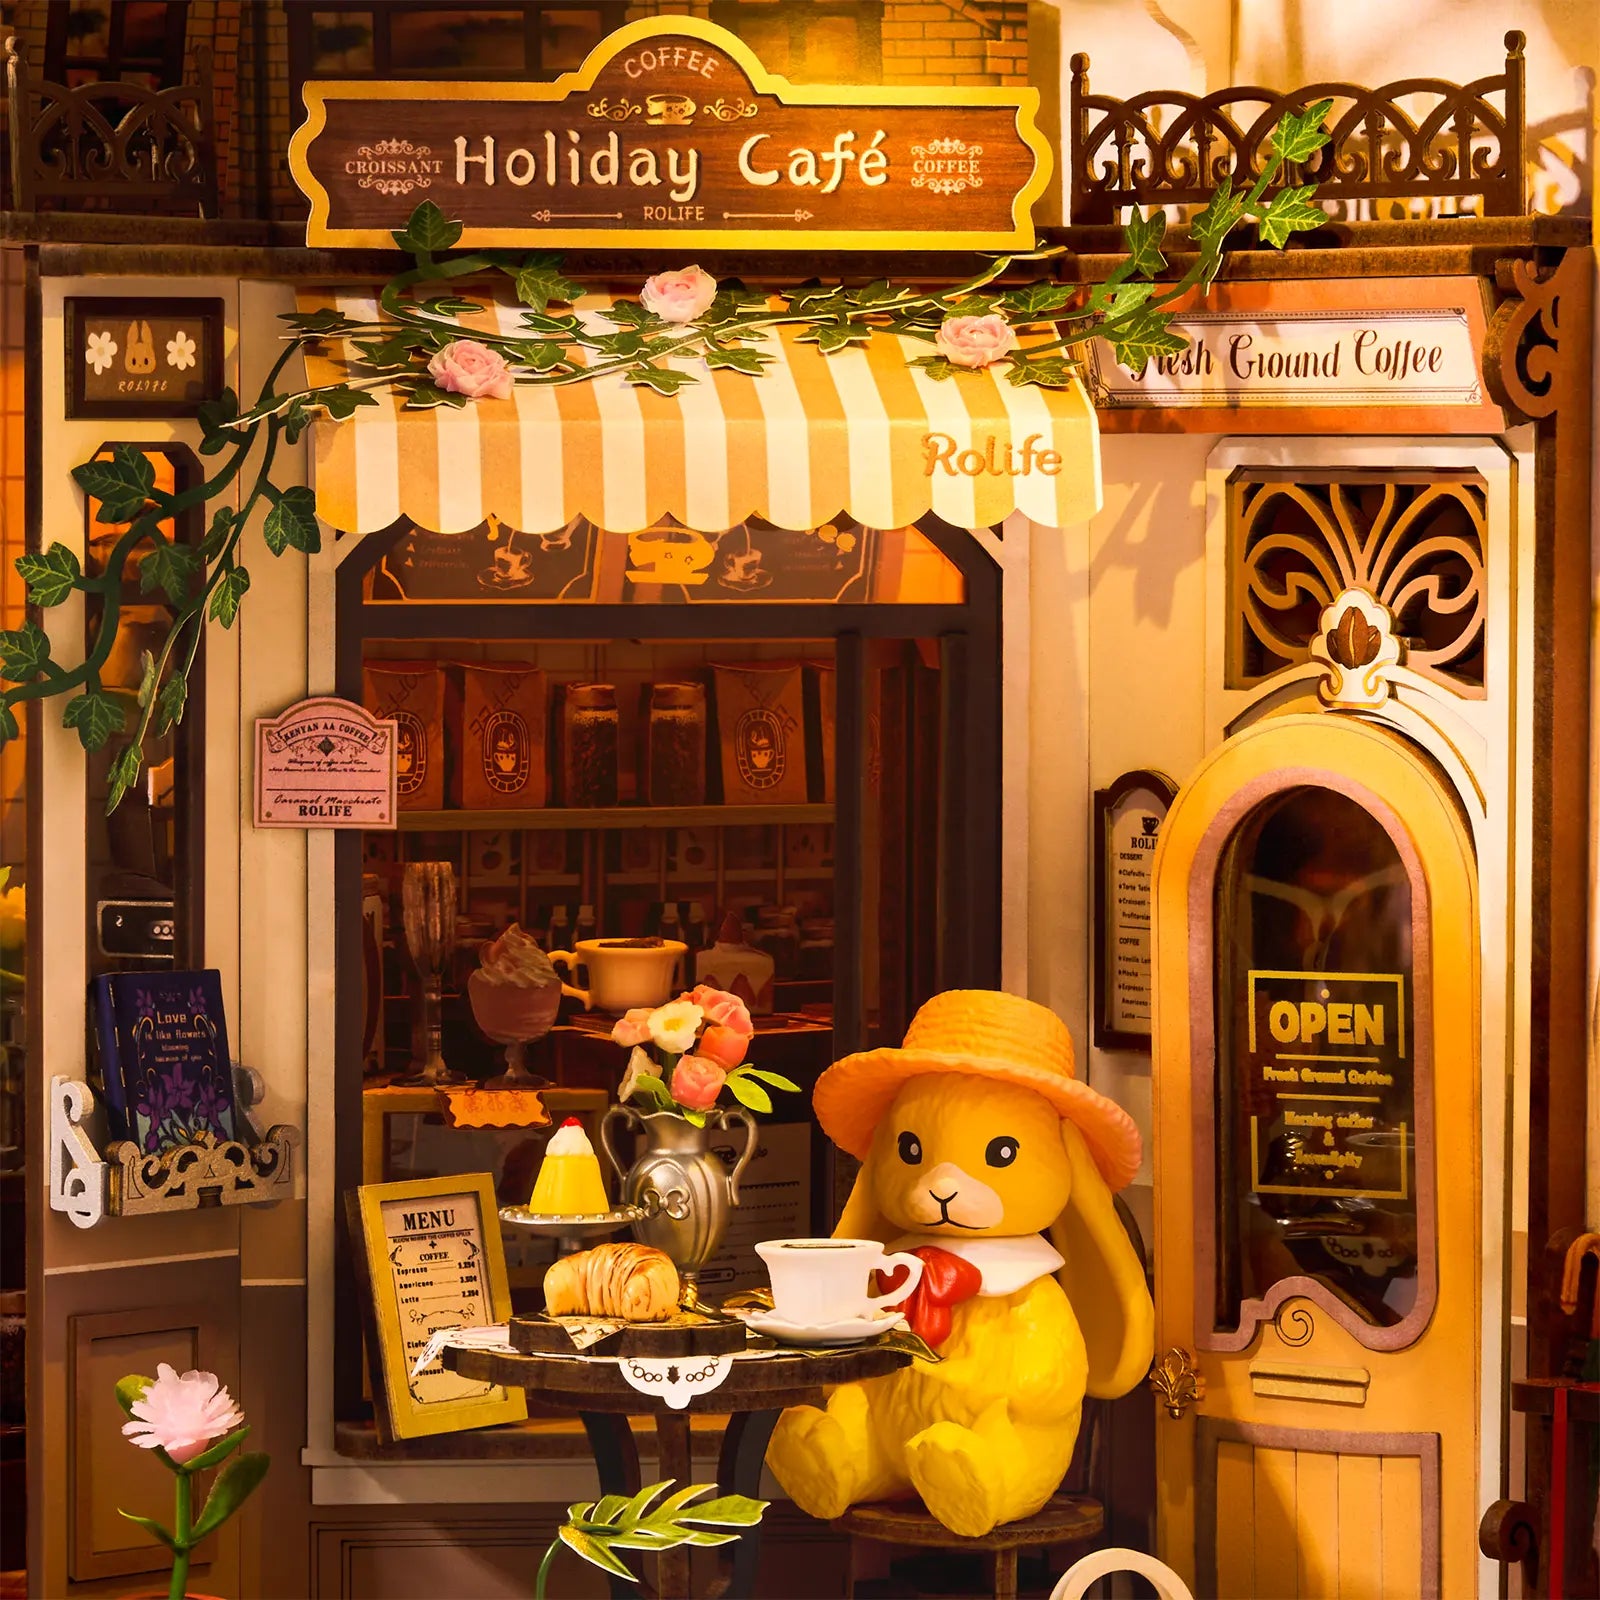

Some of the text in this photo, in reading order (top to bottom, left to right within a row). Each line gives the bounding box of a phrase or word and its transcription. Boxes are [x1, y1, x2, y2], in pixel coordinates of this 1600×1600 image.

[624, 46, 721, 79] COFFEE
[344, 159, 443, 175] CROISSANT
[453, 129, 889, 201] Holiday Café
[912, 158, 980, 174] COFFEE
[643, 205, 706, 222] ROLIFE
[1130, 328, 1444, 383] resh Ground Coffee
[921, 431, 1063, 477] Rolife
[284, 721, 371, 743] KENYAN AA COFFEE
[273, 794, 322, 805] Caramel
[298, 805, 353, 817] ROLIFE
[1130, 836, 1158, 850] ROLI
[1119, 852, 1143, 860] DESSERT
[1119, 937, 1140, 946] COFFEE
[156, 1010, 187, 1025] Love
[1268, 1000, 1385, 1046] OPEN
[155, 1030, 172, 1040] like
[175, 1028, 207, 1040] flowers
[1347, 1069, 1394, 1087] Coffee
[1323, 1130, 1335, 1147] &
[402, 1208, 455, 1232] MENU
[419, 1251, 449, 1262] COFFEE
[397, 1266, 428, 1276] Espresso
[399, 1280, 434, 1290] Americano
